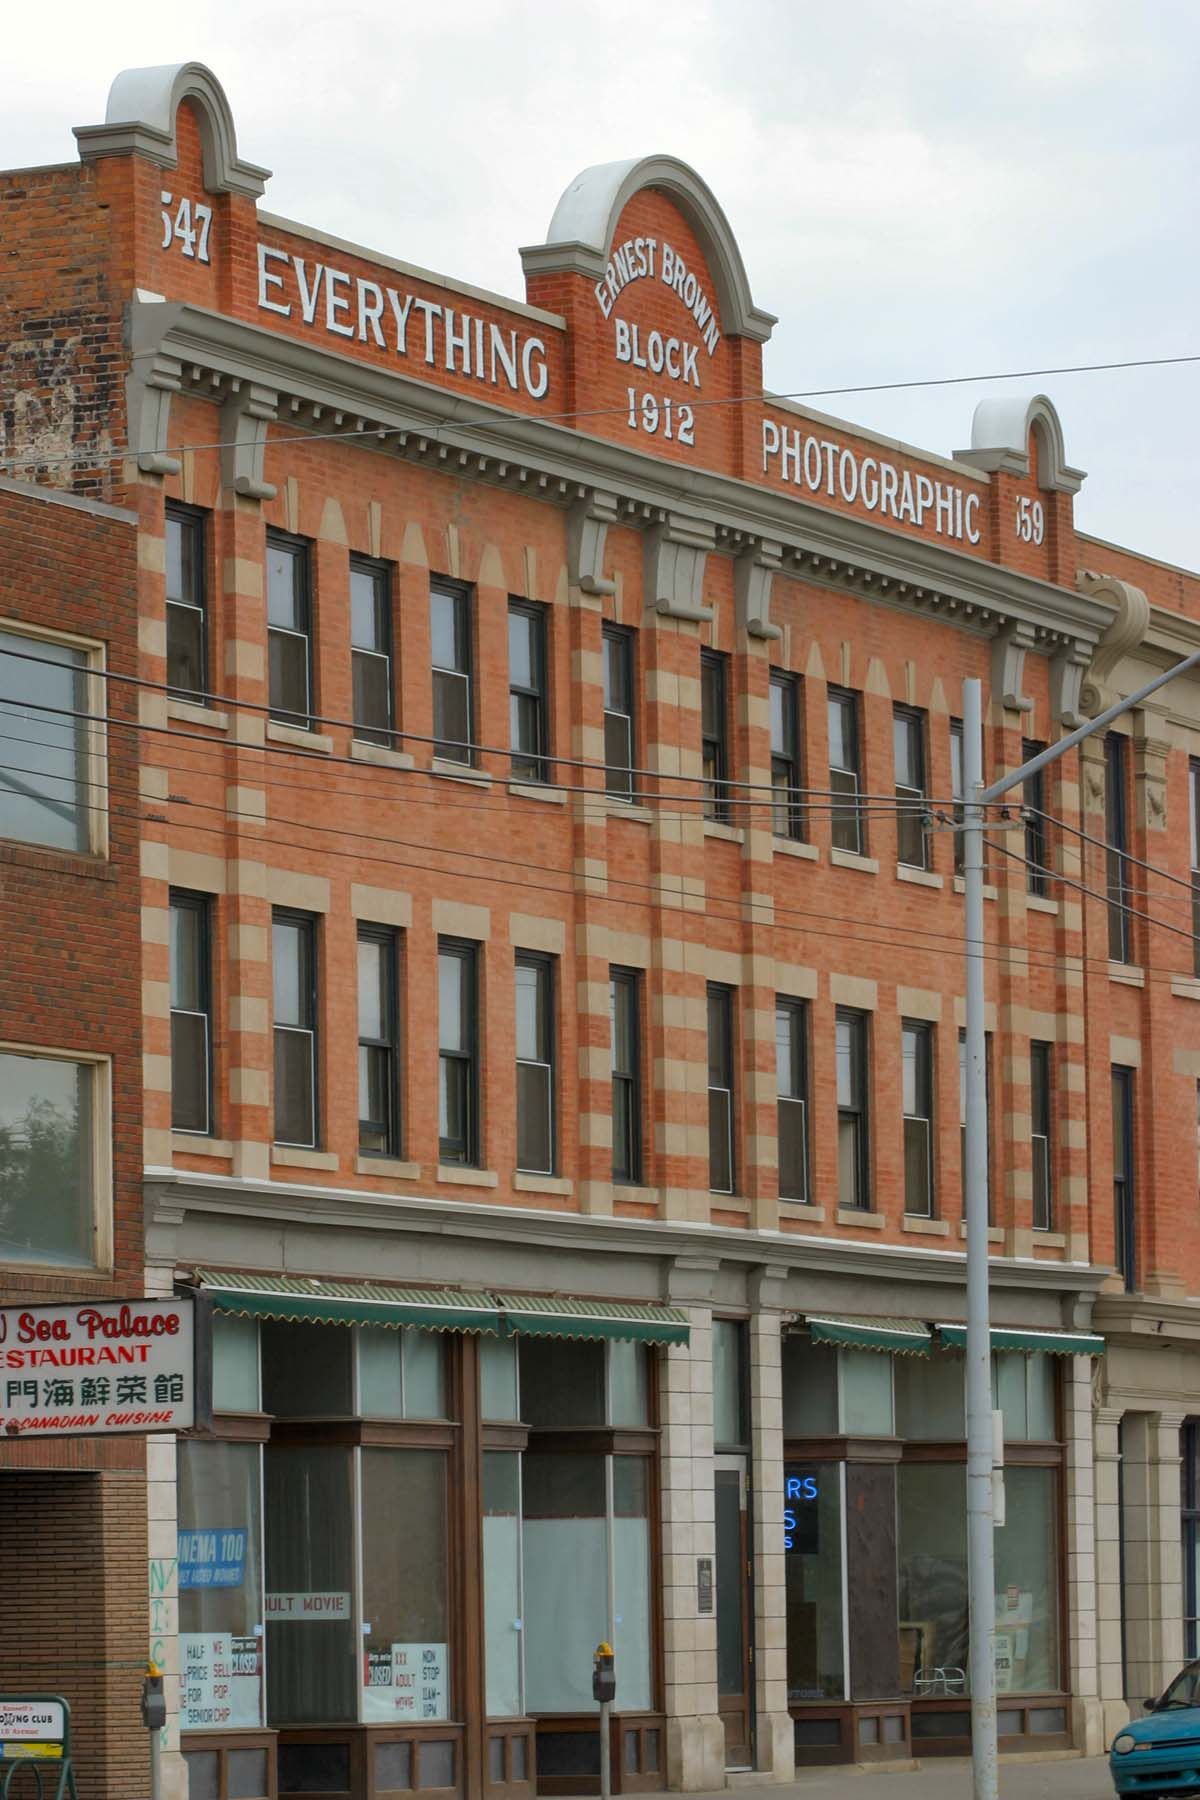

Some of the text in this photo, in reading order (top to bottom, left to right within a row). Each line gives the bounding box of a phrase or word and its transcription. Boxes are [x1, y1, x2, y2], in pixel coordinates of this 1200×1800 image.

[594, 237, 720, 356] ERNEST BROWN
[256, 242, 549, 399] EVERYTHING
[615, 318, 700, 387] BLOCK
[627, 387, 695, 445] 1912
[762, 418, 981, 545] PHOTOGRAPHIC
[1016, 495, 1044, 545] 59
[17, 1312, 71, 1344] Sea
[77, 1304, 180, 1340] Palace
[0, 1344, 152, 1369] STAURANT
[222, 1533, 243, 1562] 100
[303, 1597, 344, 1611] MOVIE
[187, 1644, 205, 1660] HALF
[187, 1666, 208, 1681] PRICE
[213, 1664, 231, 1678] SELL
[423, 1666, 440, 1681] STOP
[187, 1688, 202, 1702] FOR
[31, 1714, 53, 1724] CLUB
